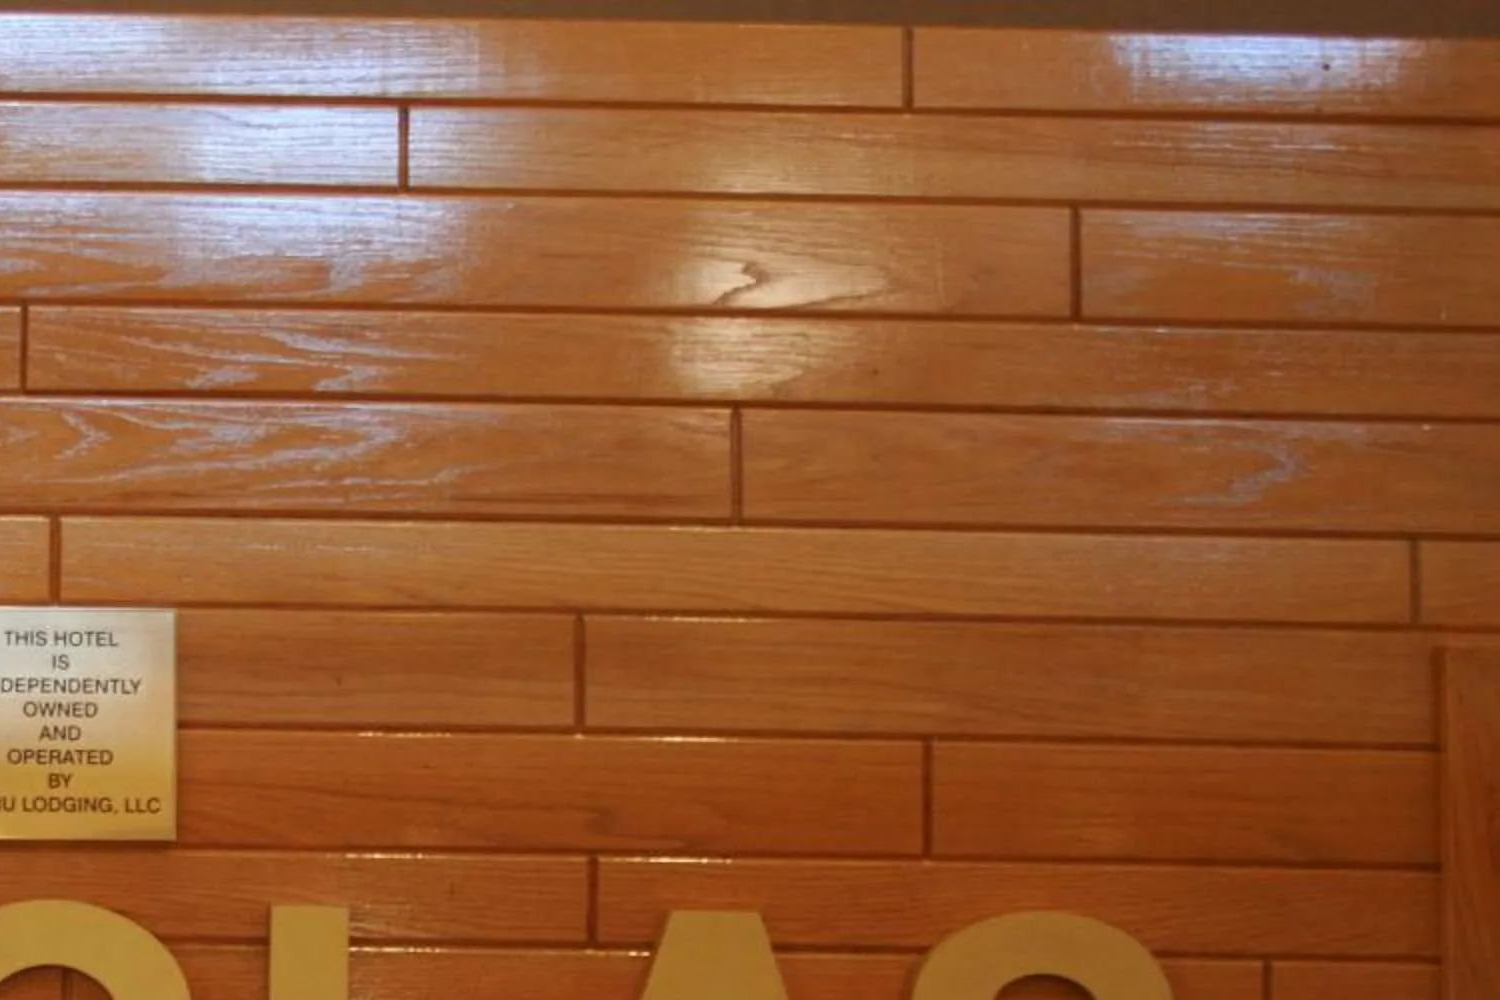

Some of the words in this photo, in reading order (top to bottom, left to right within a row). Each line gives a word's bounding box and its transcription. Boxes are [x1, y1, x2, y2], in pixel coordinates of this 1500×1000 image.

[4, 630, 47, 647] THIS
[54, 630, 119, 648] HOTEL
[52, 654, 70, 670] IS
[23, 701, 98, 718] OWNED
[39, 725, 81, 741] AND
[7, 749, 114, 765] OPERATED
[47, 773, 73, 789] BY
[22, 796, 119, 814] LODGING,
[125, 797, 161, 813] LLC
